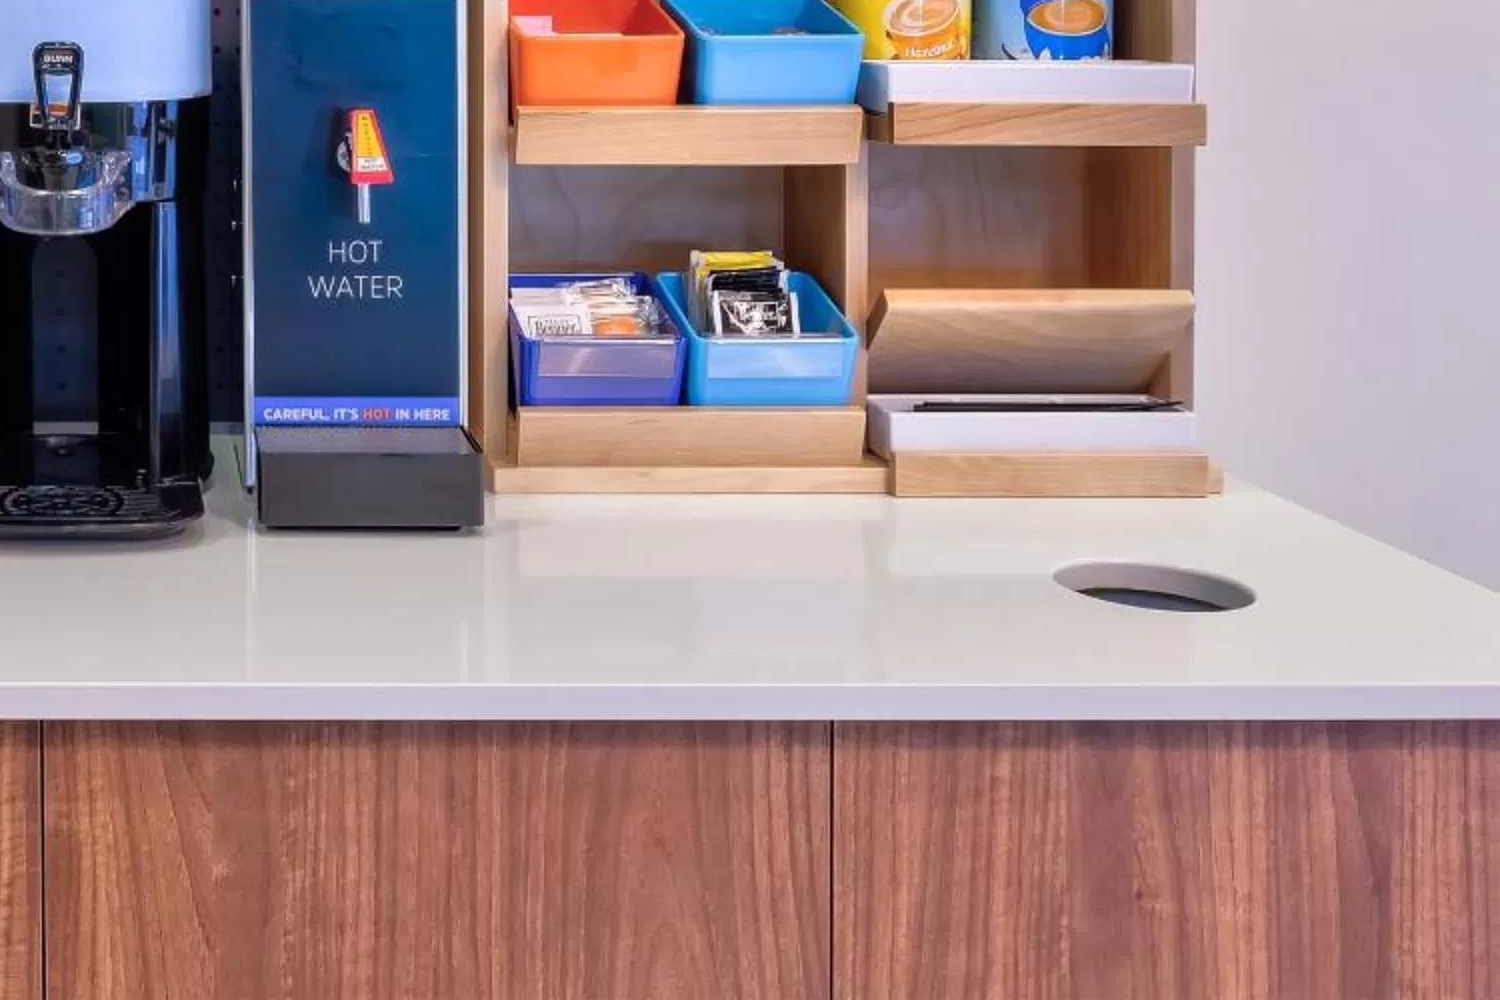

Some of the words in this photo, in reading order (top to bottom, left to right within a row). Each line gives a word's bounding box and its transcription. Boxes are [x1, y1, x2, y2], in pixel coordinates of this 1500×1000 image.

[327, 240, 384, 265] HOT
[307, 274, 404, 300] WATER
[333, 407, 359, 421] IT'S
[363, 407, 389, 420] HOT
[395, 407, 410, 420] IN
[413, 407, 451, 421] HERE
